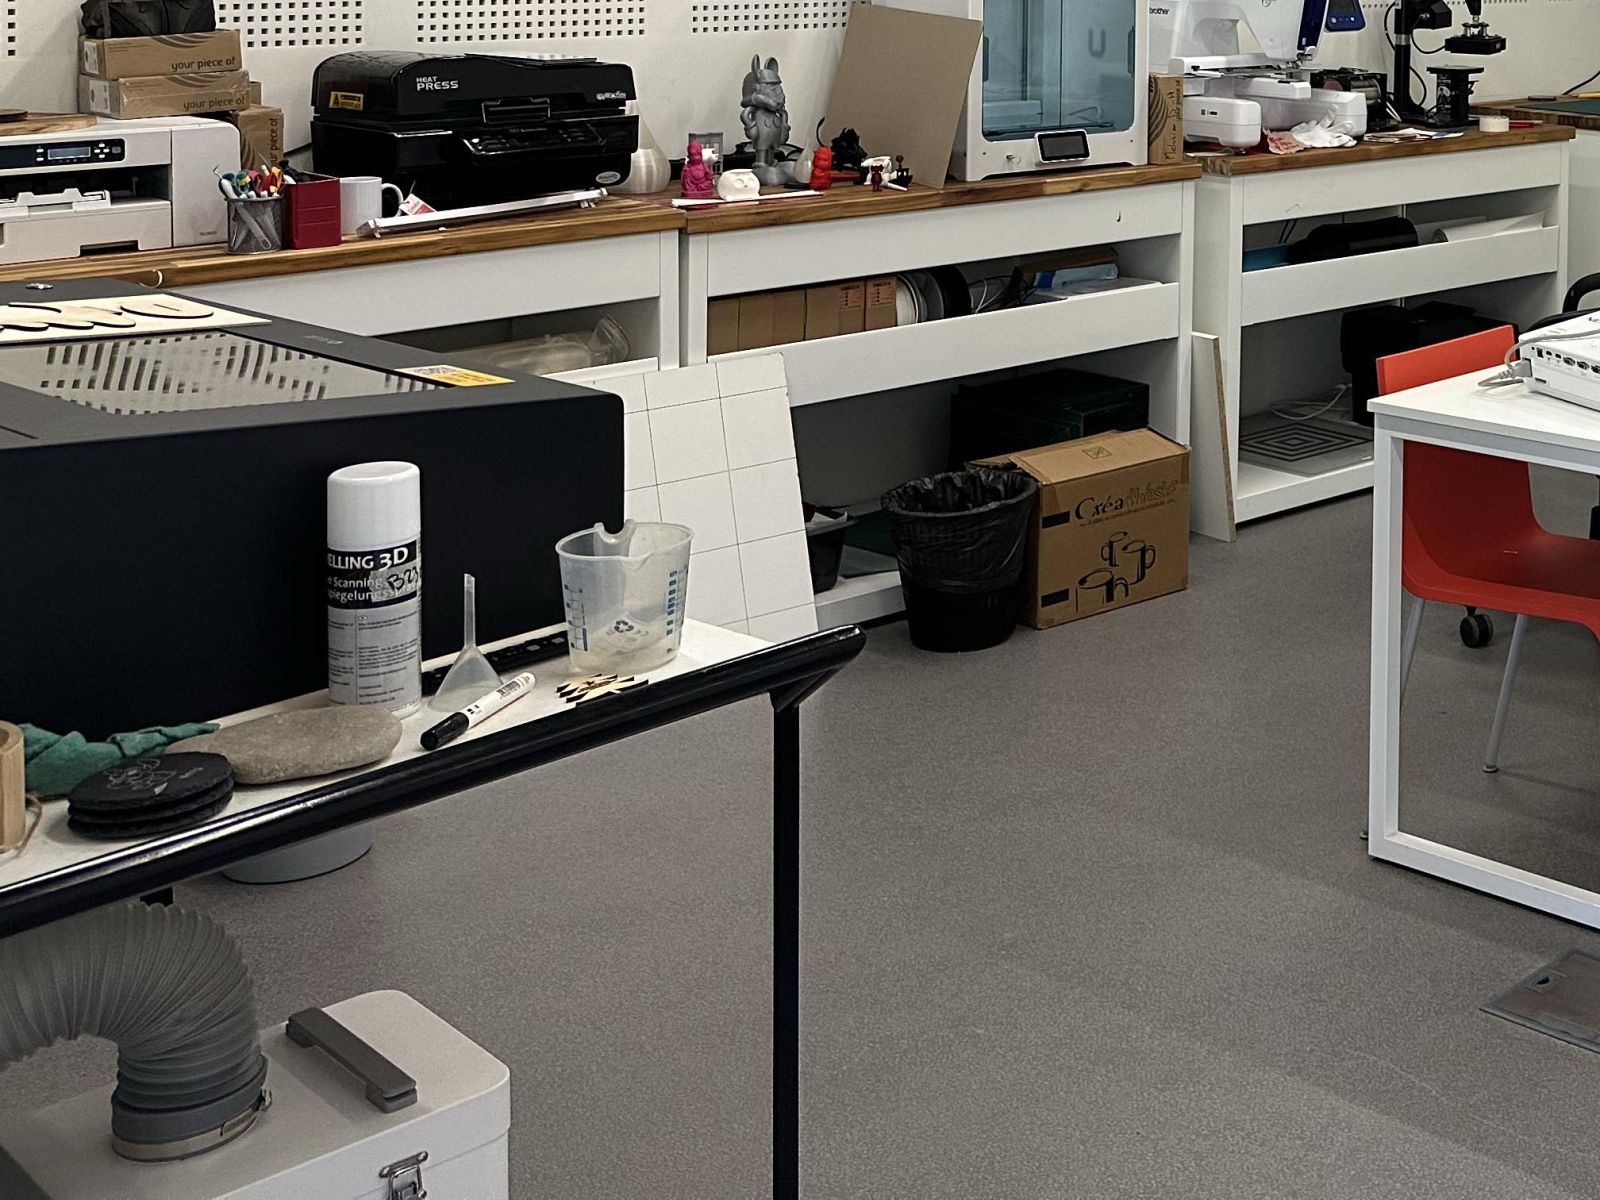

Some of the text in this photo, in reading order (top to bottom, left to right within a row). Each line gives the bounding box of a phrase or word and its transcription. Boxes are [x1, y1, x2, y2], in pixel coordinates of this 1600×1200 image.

[1149, 7, 1170, 15] brother
[171, 56, 236, 72] your piece of
[417, 81, 459, 91] PRESS
[183, 96, 245, 112] your piece of
[380, 547, 409, 571] 3D
[333, 576, 383, 589] Scanning
